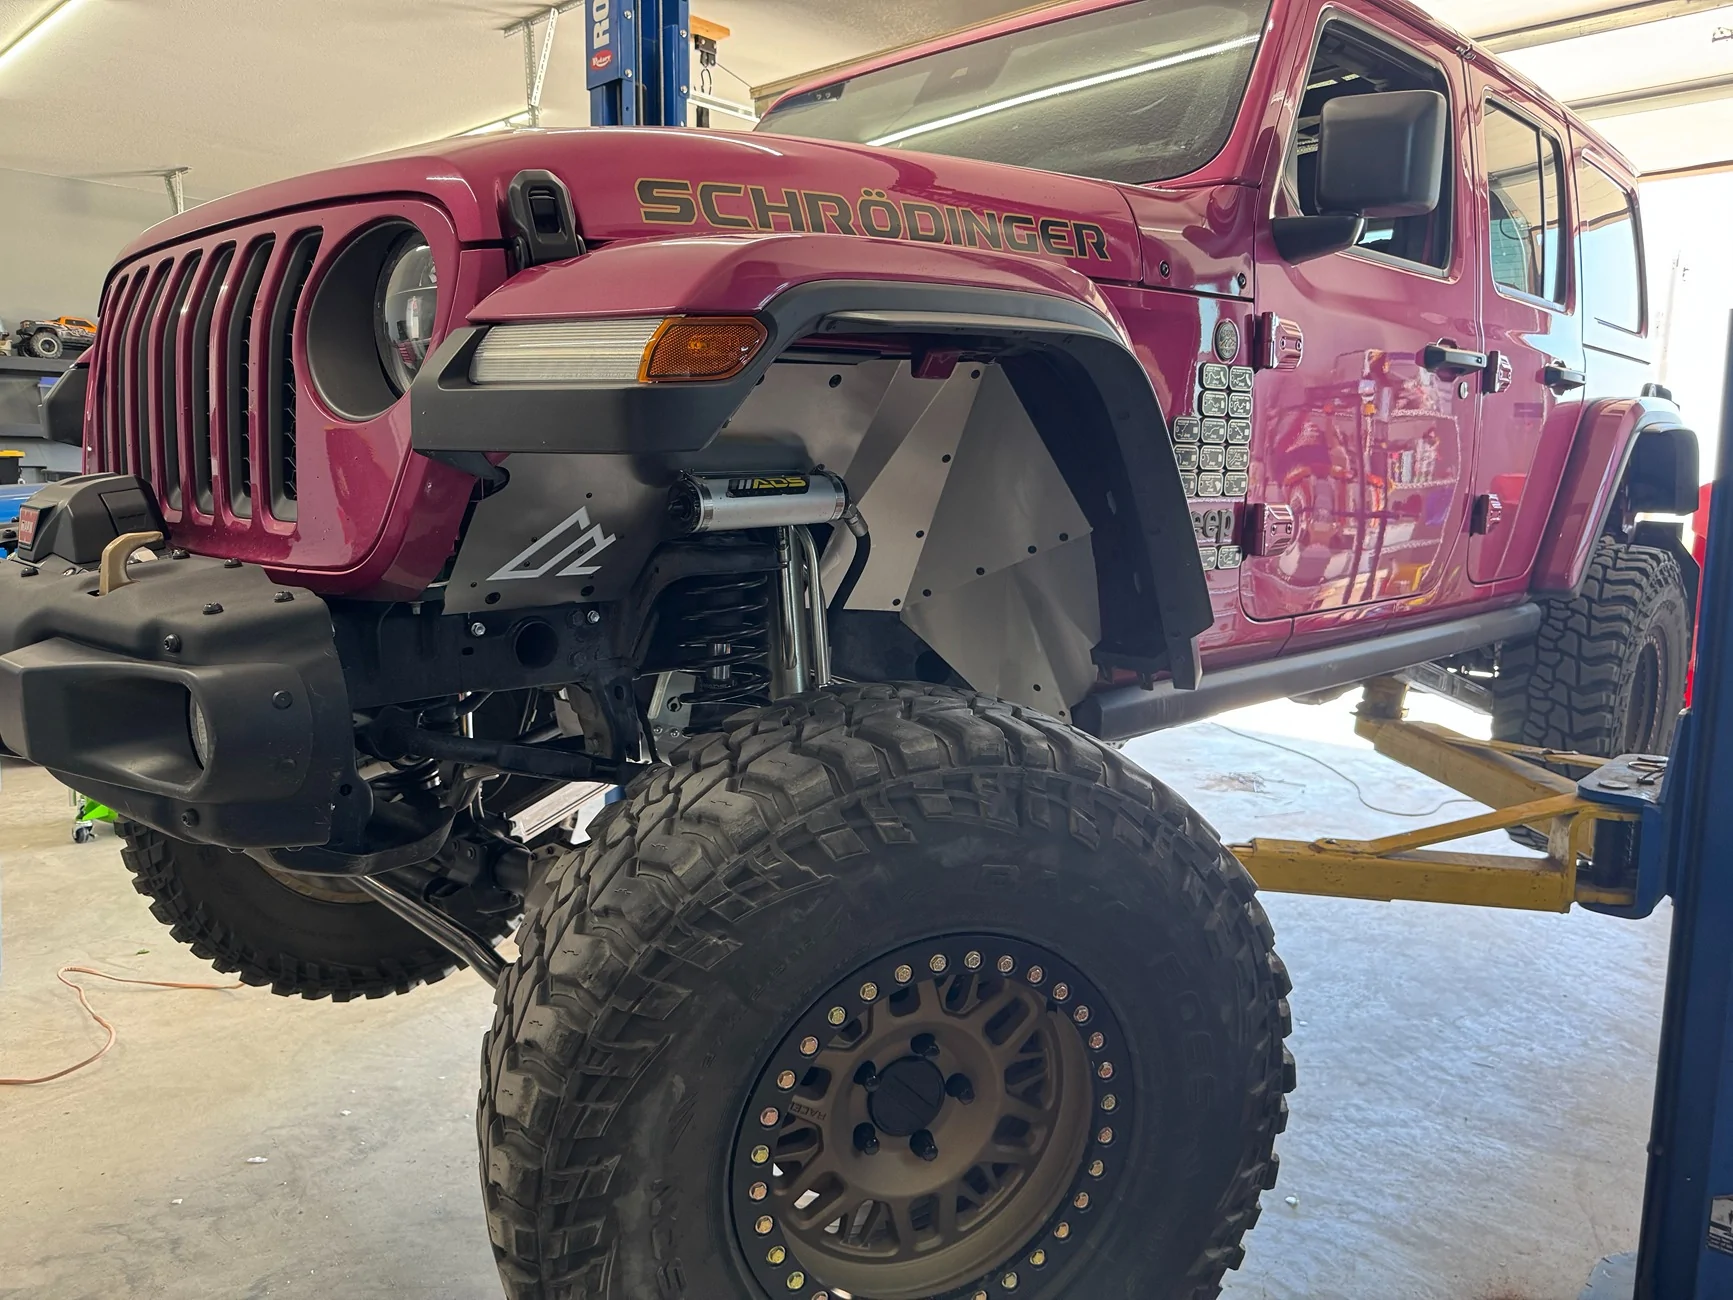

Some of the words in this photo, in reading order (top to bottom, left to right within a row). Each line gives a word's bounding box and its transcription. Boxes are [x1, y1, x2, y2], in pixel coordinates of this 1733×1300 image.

[635, 177, 1111, 262] SCHRÖDINGER
[753, 477, 806, 489] ADS
[1191, 509, 1235, 543] eep
